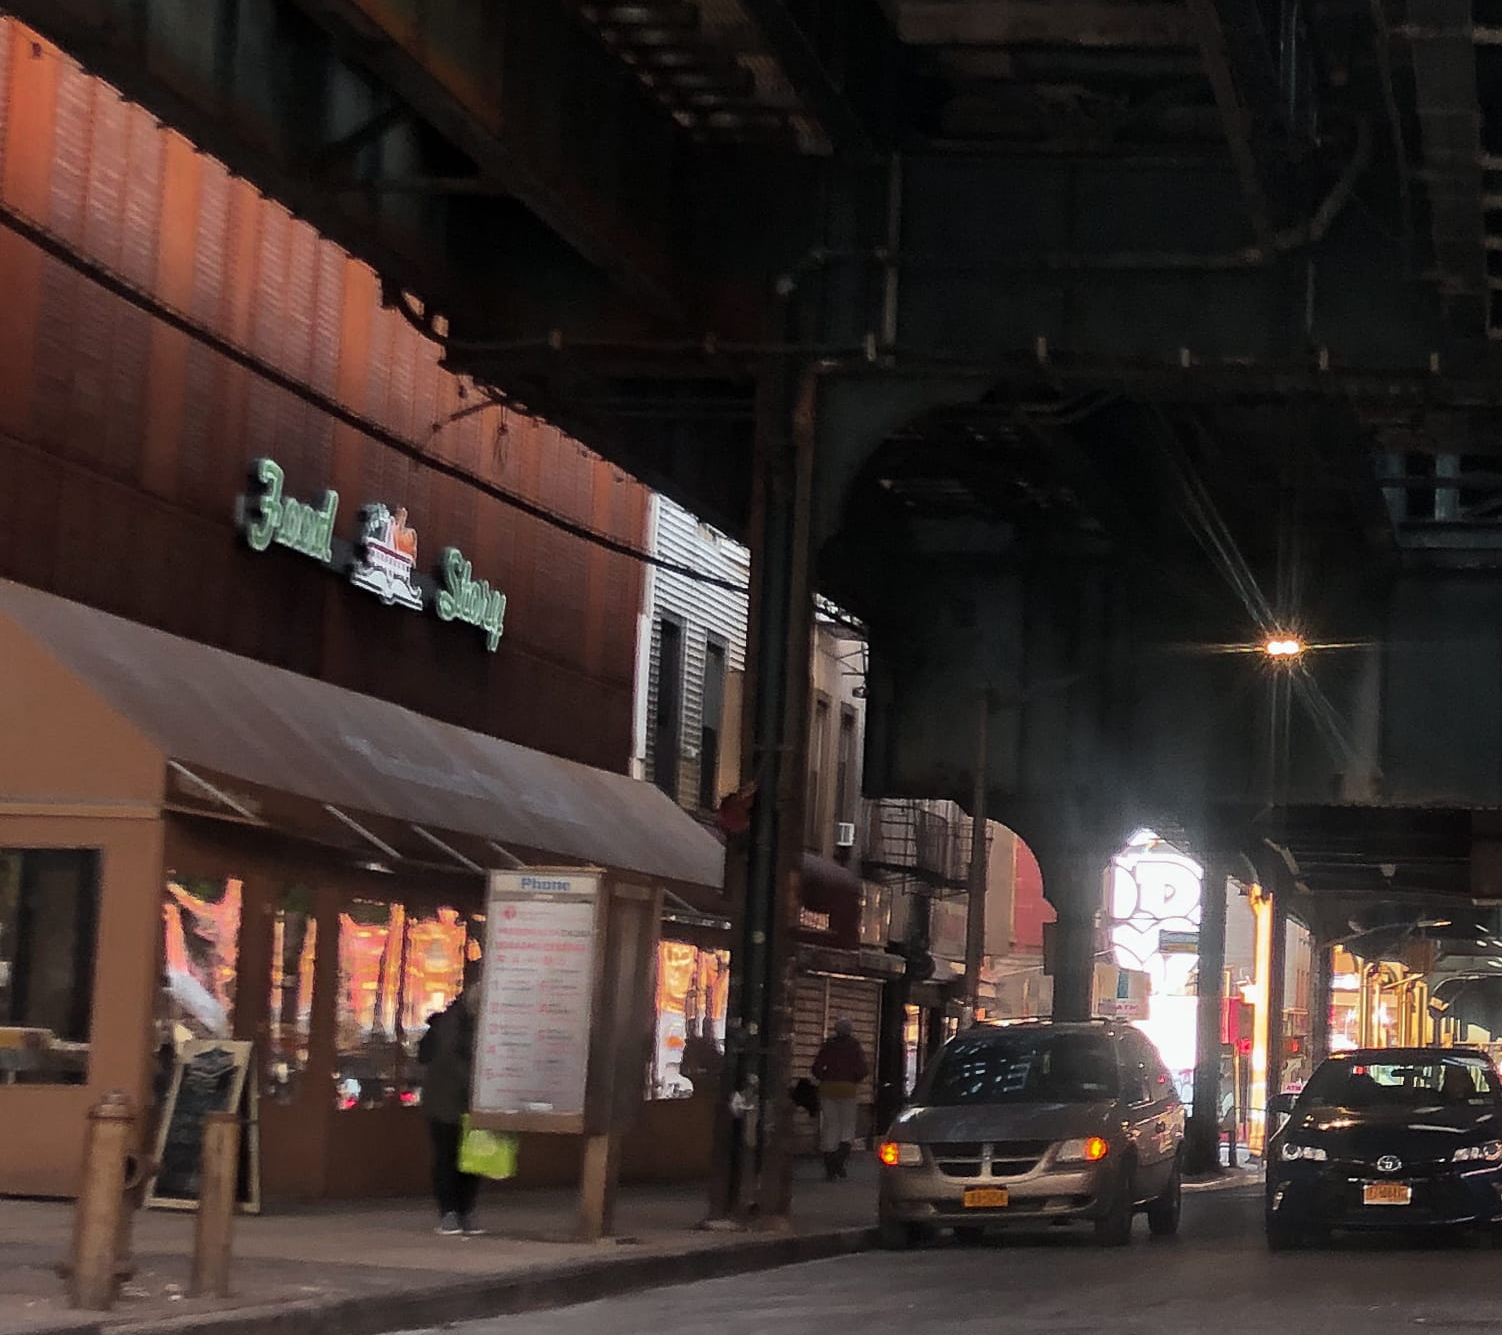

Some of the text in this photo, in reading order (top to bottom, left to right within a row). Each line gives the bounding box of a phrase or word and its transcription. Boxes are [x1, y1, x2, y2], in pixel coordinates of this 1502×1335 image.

[248, 457, 507, 653] Food Story
[520, 877, 571, 891] Phone
